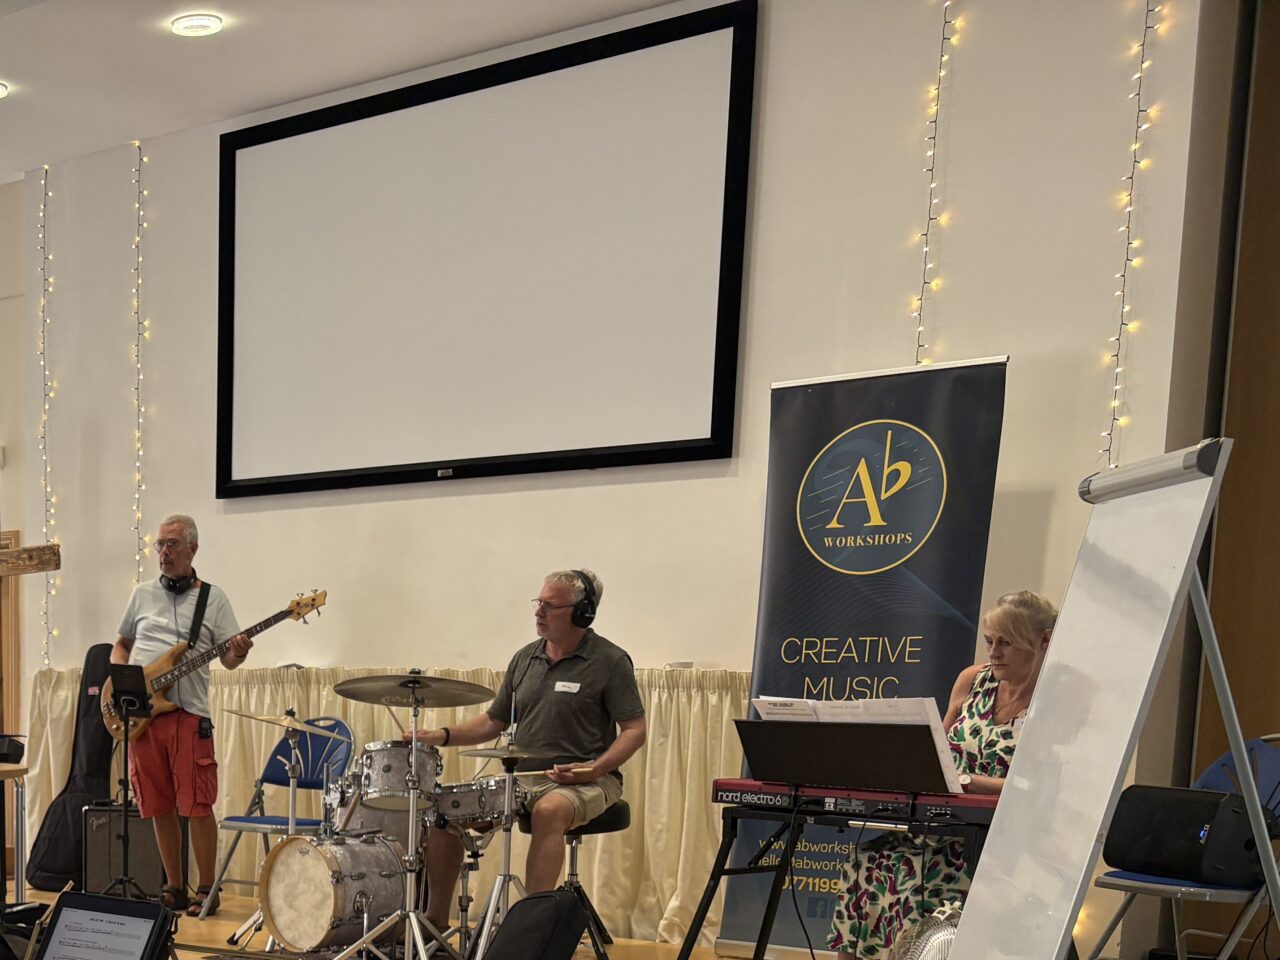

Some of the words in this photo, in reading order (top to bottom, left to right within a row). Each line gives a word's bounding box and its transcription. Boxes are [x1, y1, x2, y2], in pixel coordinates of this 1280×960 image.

[823, 532, 913, 548] WORKSHOPS
[781, 636, 923, 664] CREATIVE
[803, 676, 900, 702] MUSIC
[718, 791, 740, 802] nord
